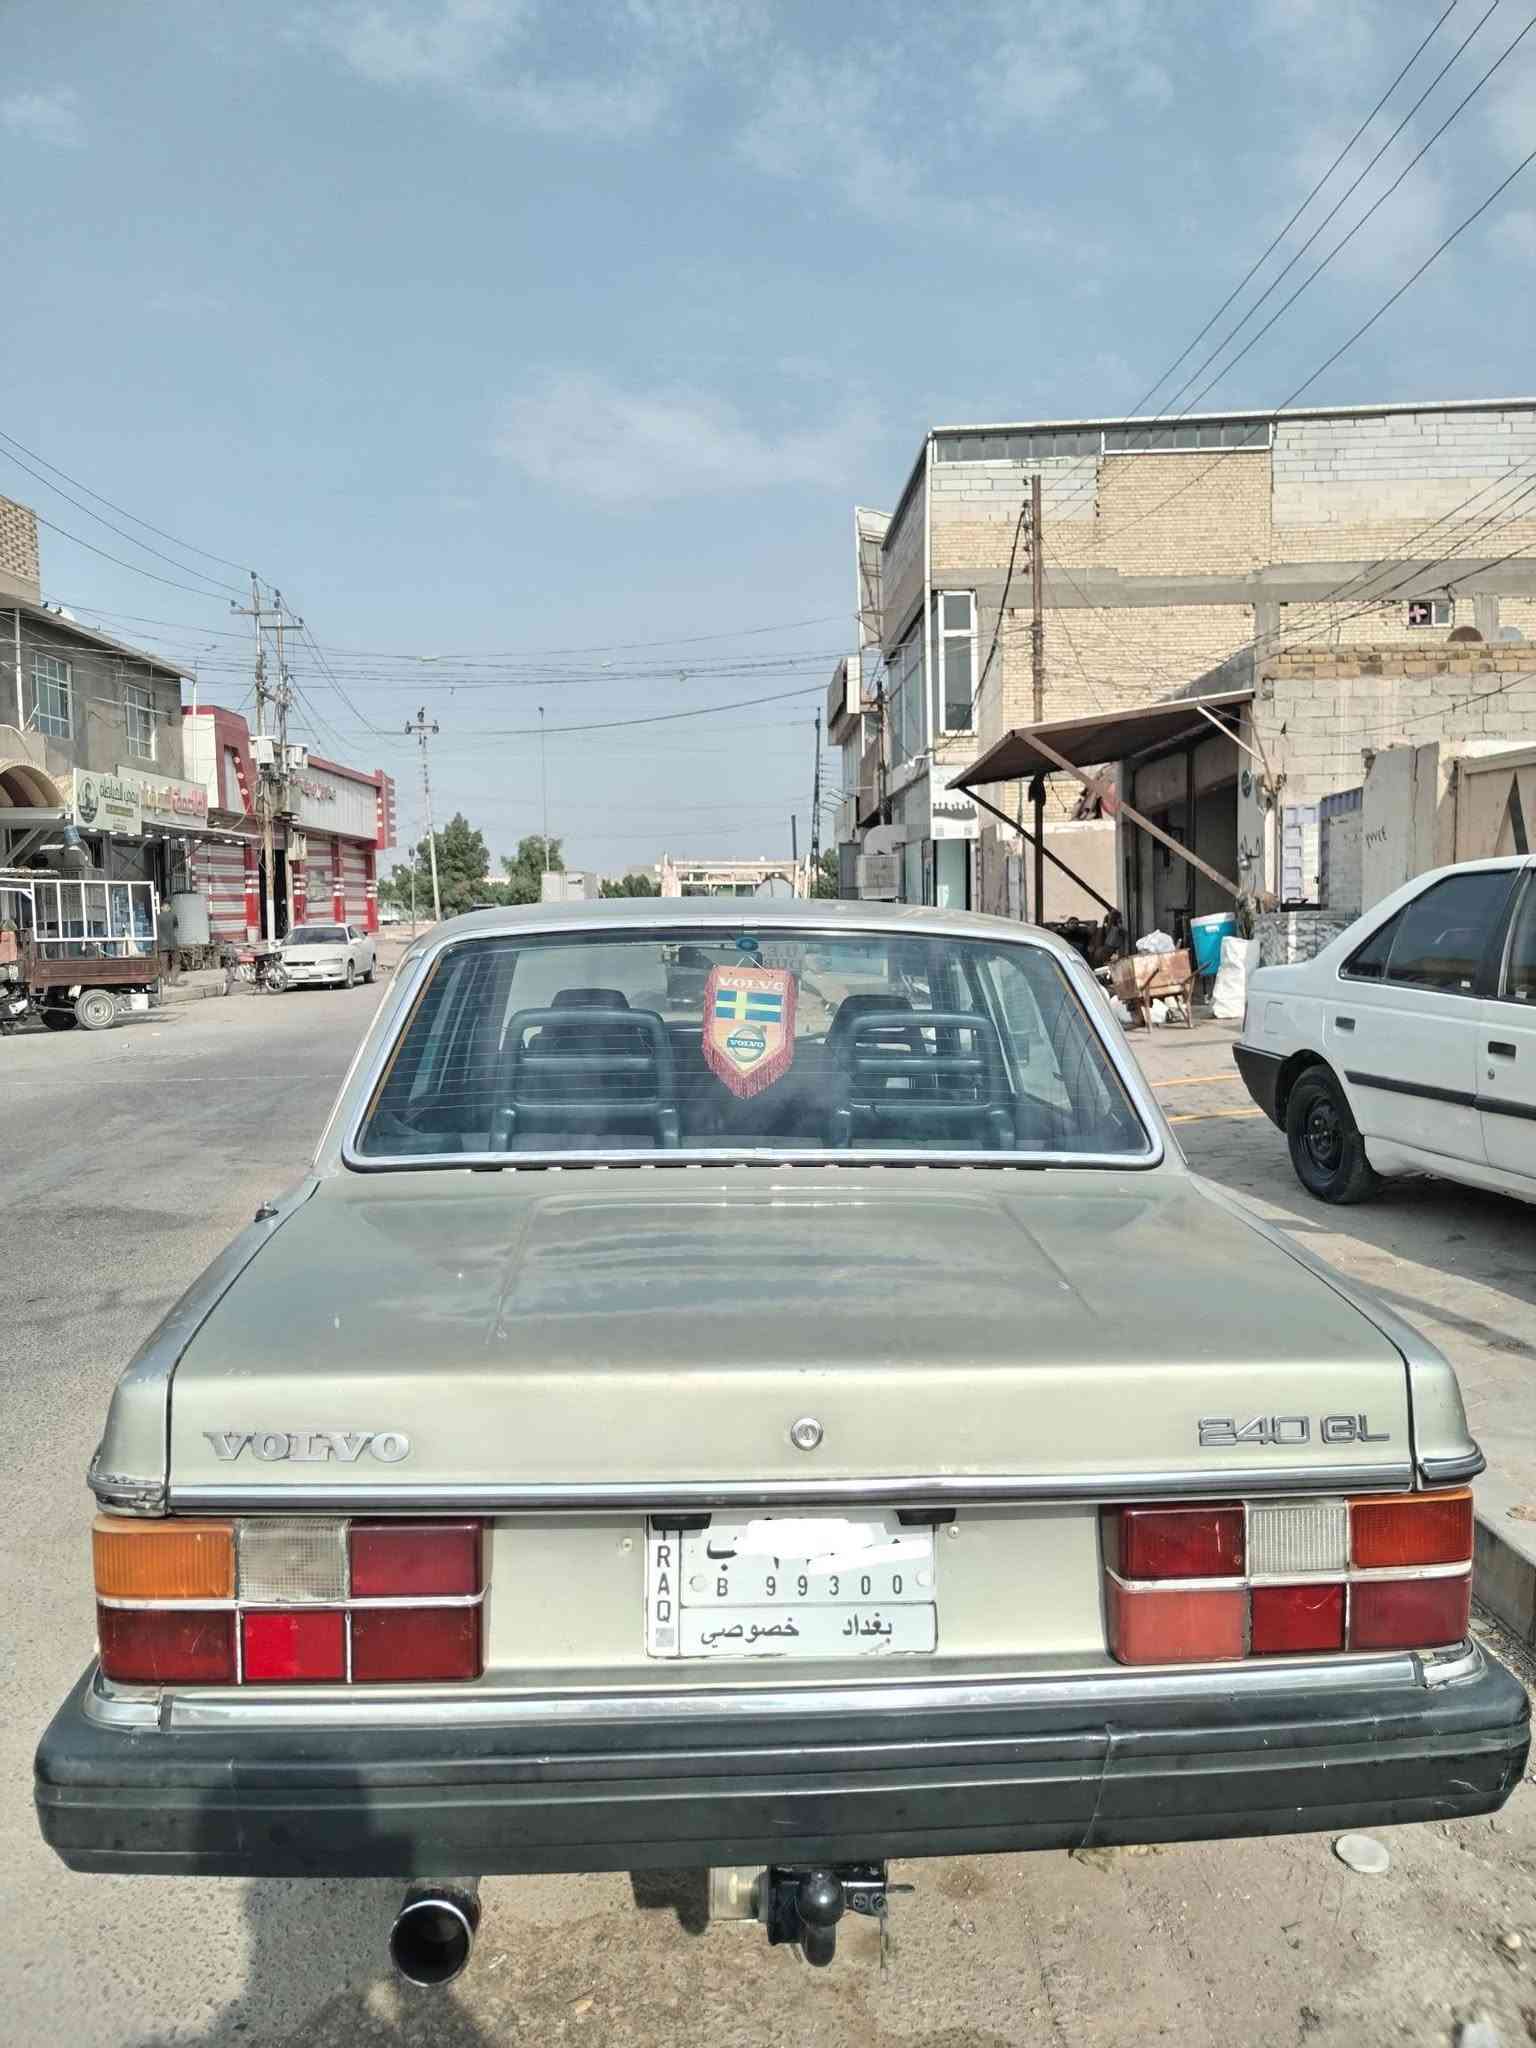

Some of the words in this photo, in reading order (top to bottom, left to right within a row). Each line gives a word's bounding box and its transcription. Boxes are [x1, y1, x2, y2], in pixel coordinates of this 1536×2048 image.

[719, 977, 785, 991] VOLVO
[729, 1039, 764, 1048] VOLVO
[1199, 1415, 1311, 1446] 240
[1320, 1413, 1391, 1444] GL
[202, 1431, 411, 1463] VOLVO
[716, 1576, 729, 1597] B
[766, 1574, 903, 1597] 99300
[700, 1615, 800, 1648] خصوصي
[842, 1612, 893, 1644] بغداد
